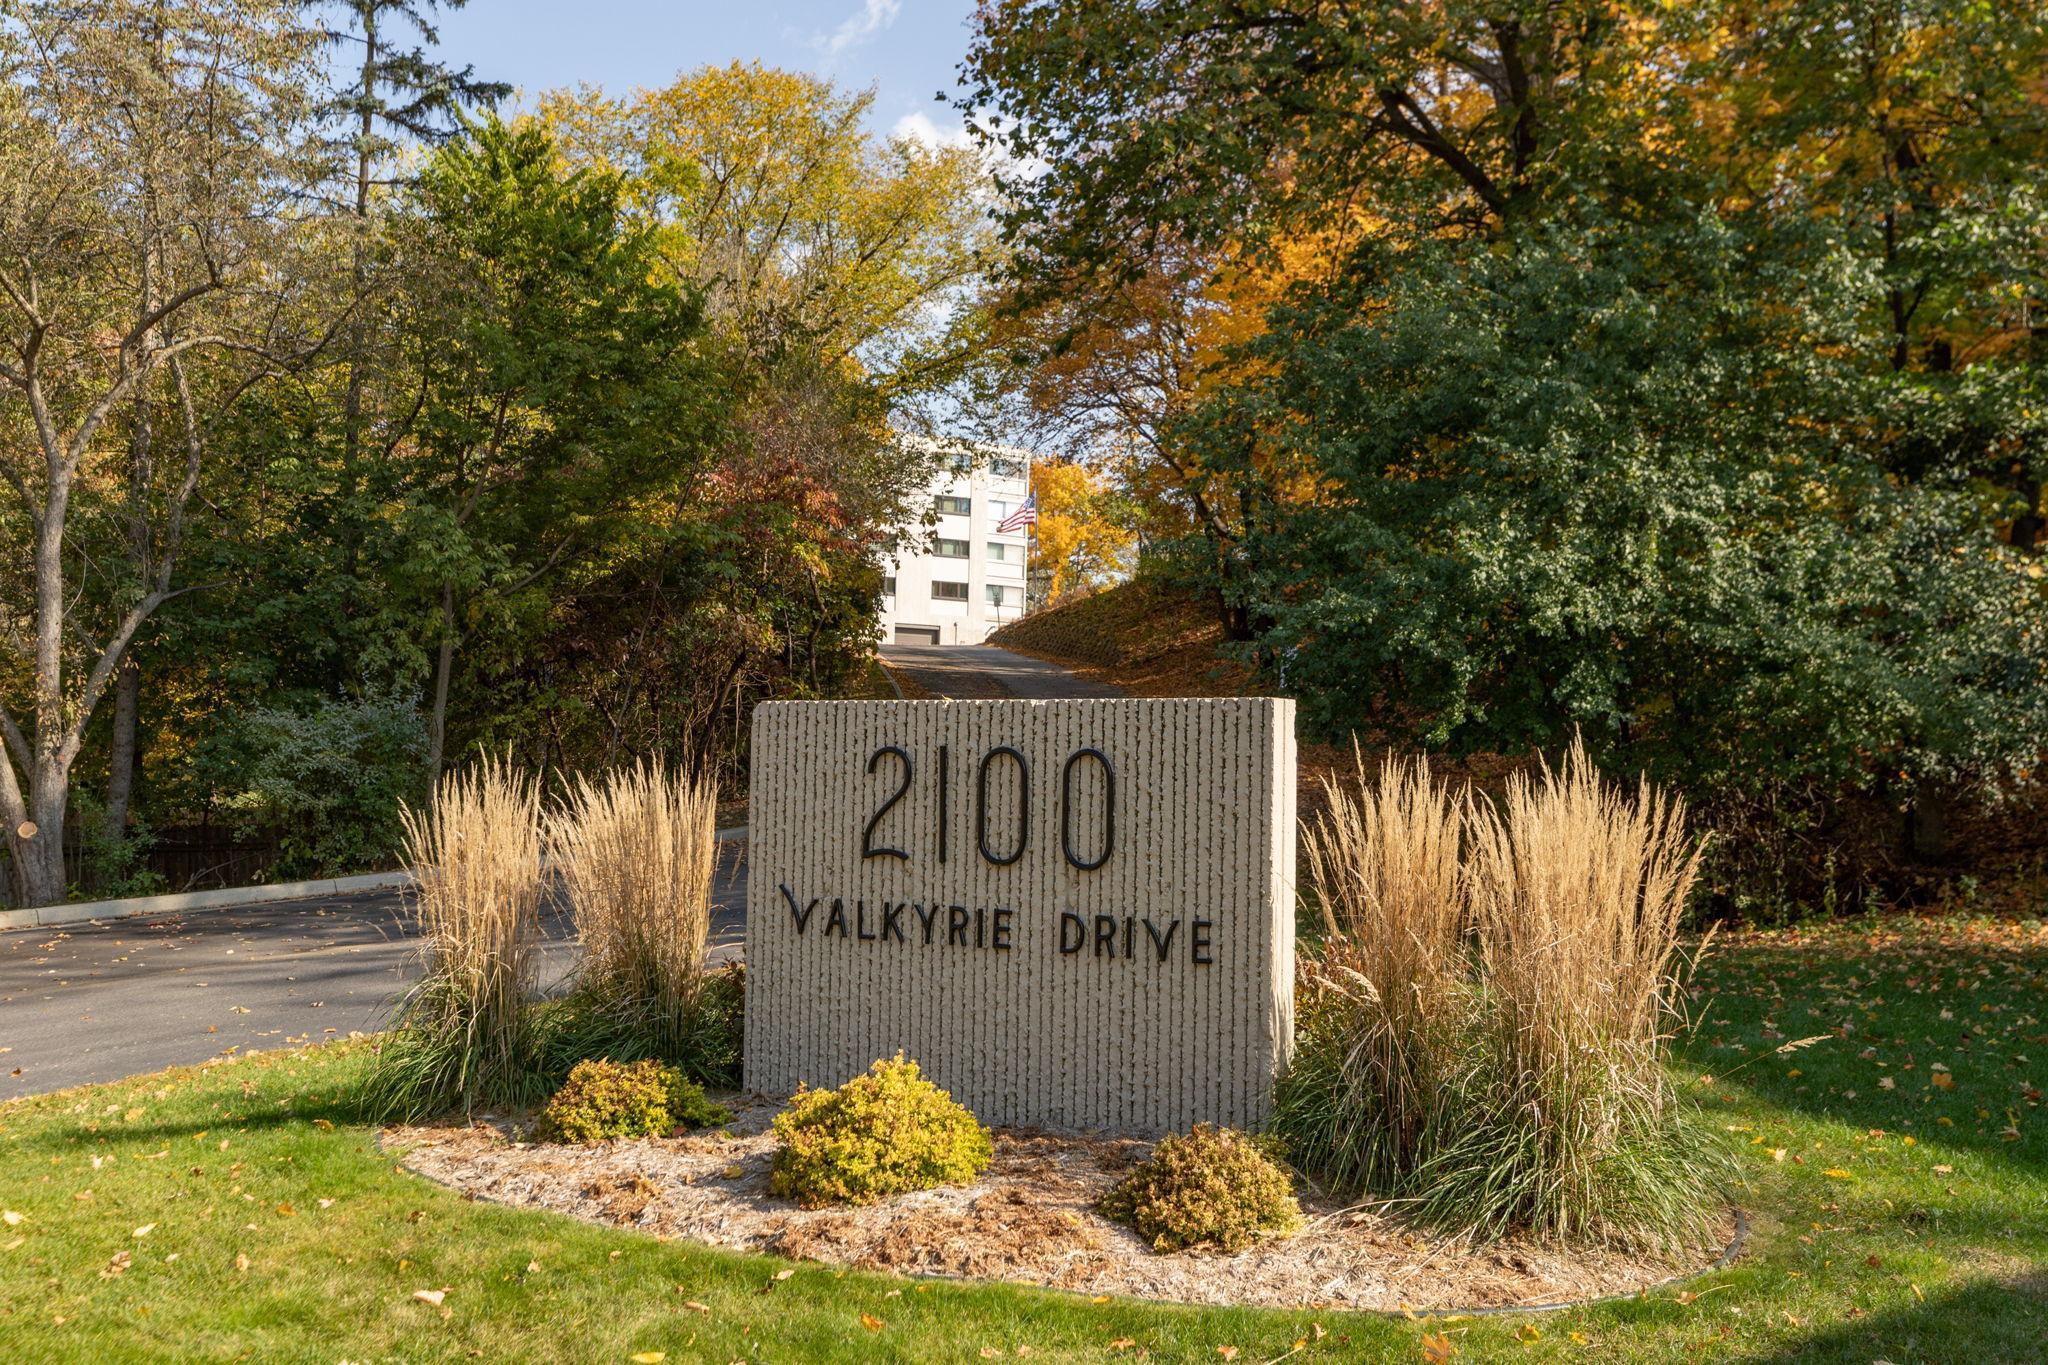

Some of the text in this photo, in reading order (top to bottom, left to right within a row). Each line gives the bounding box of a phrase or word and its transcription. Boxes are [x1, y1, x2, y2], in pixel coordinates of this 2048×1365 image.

[861, 745, 1116, 871] 2100
[778, 883, 1213, 965] VALKYRIE DRIVE
